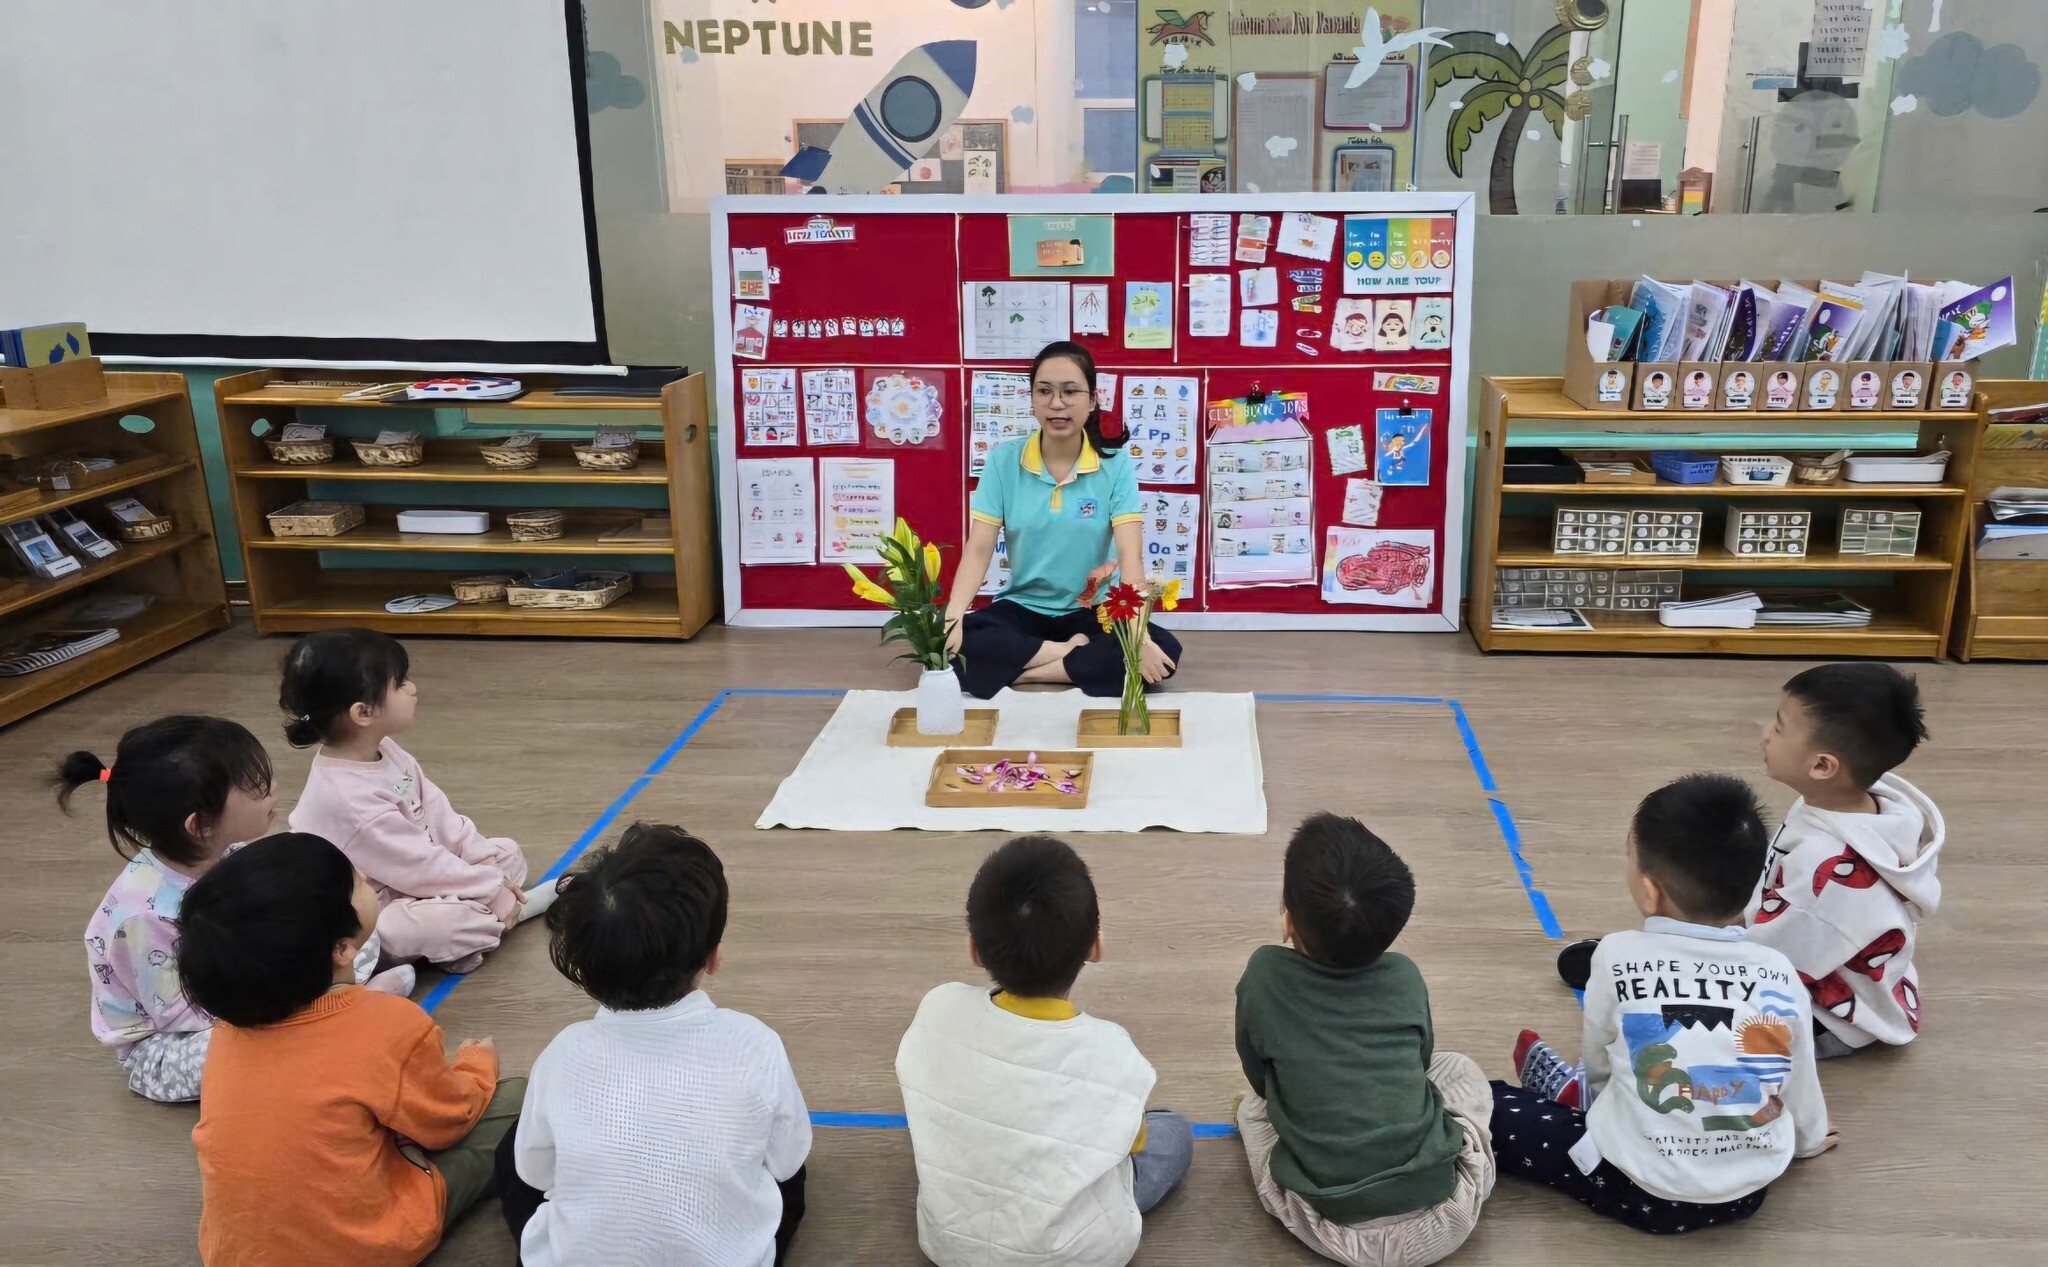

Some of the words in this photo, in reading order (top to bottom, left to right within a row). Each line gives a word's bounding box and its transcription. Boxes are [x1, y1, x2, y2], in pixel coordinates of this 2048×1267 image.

[663, 20, 873, 56] NEPTUNE
[1386, 277, 1409, 286] ARE
[1148, 429, 1171, 444] Pp
[1612, 960, 1681, 976] SHAPE
[1693, 962, 1748, 976] YOUR
[1757, 968, 1789, 985] OWN
[1615, 976, 1757, 1003] REALITY
